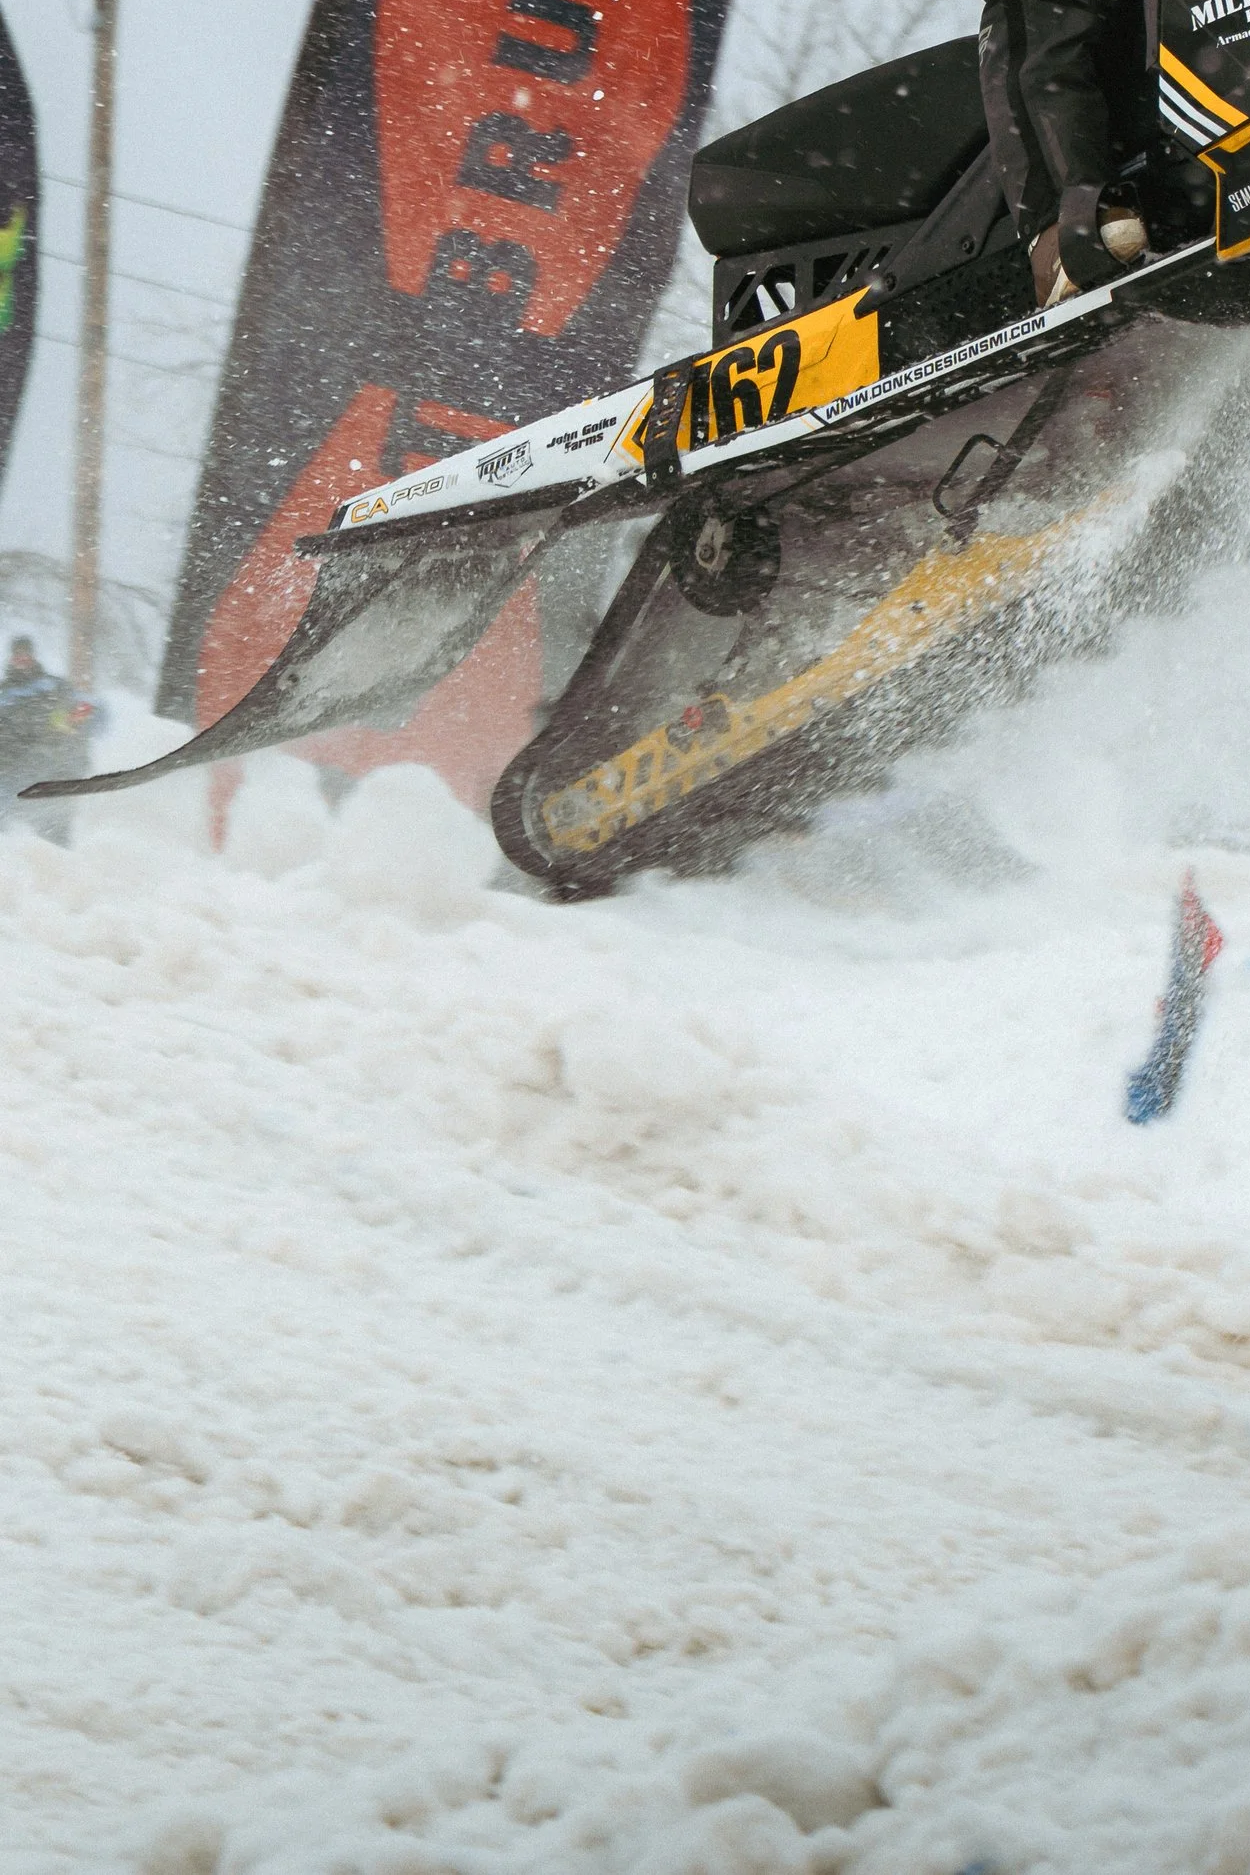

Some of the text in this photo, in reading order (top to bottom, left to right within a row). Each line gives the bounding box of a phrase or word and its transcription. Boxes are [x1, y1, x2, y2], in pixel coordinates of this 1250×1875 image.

[826, 315, 1046, 420] WWW.DONKSDESIGNSMI.COM
[546, 416, 617, 448] John Goike
[564, 432, 604, 454] Farms
